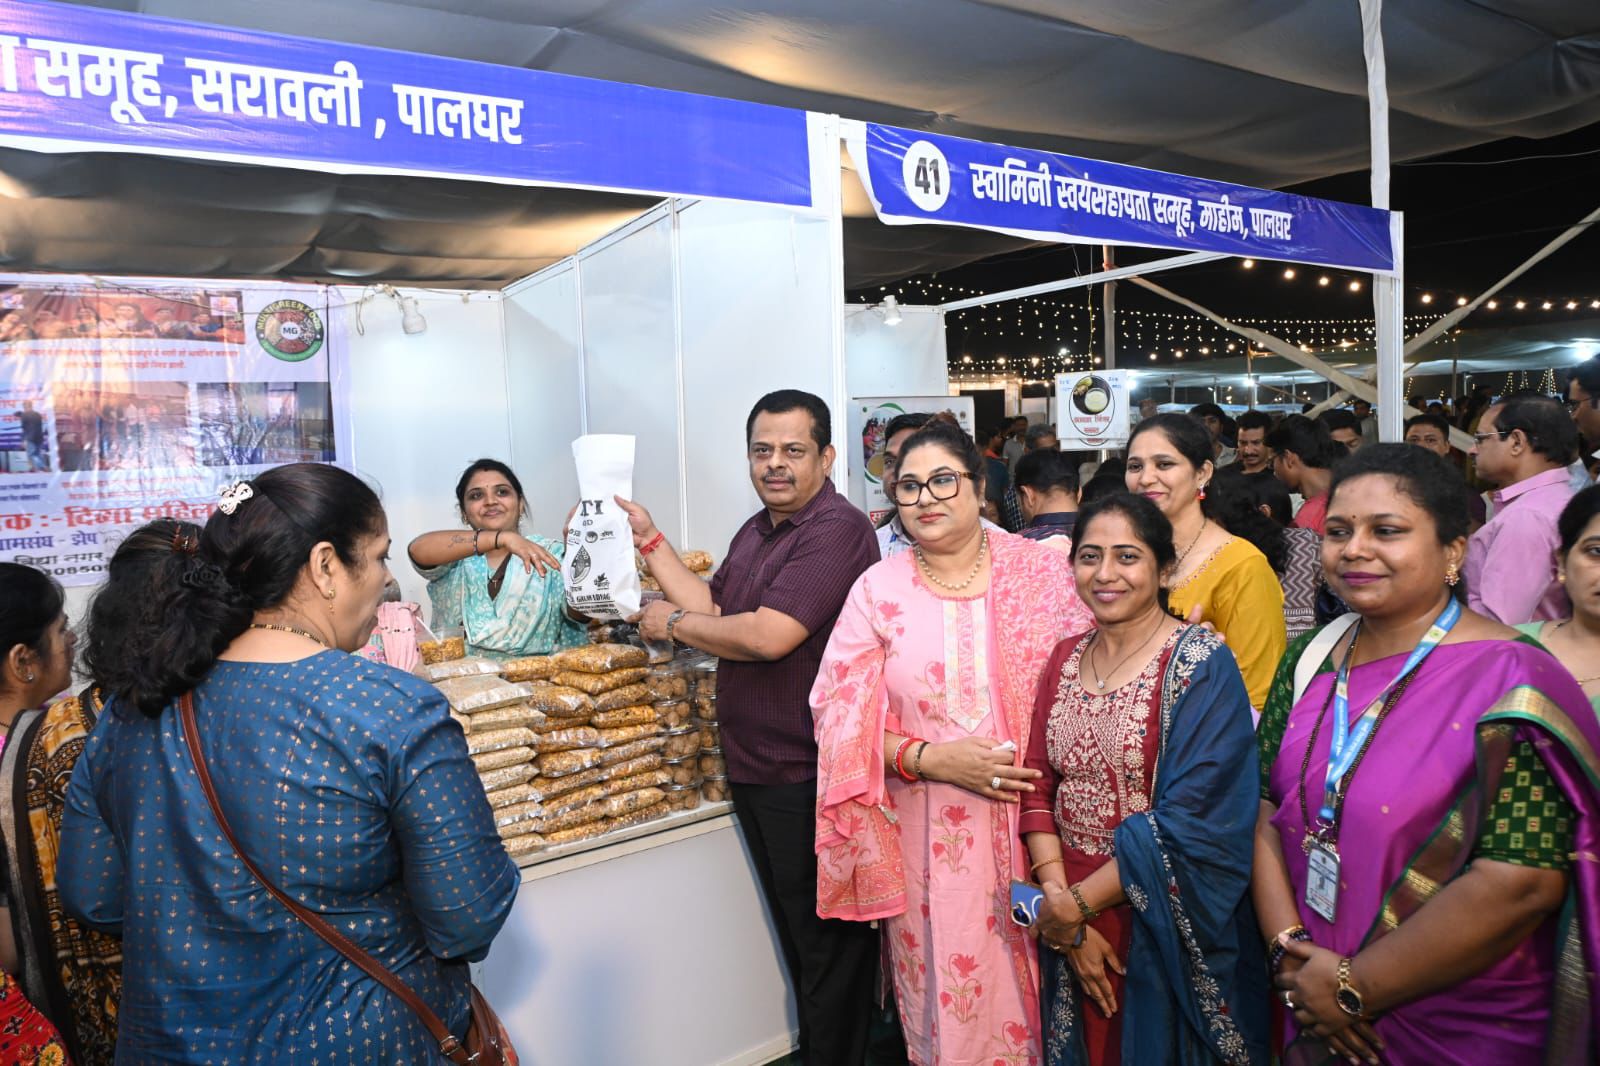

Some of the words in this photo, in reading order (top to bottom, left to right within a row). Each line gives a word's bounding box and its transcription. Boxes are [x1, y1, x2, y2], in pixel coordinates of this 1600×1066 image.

[26, 38, 178, 124] समूह,
[184, 58, 364, 127] सरावली
[392, 84, 524, 145] पालघर
[914, 157, 941, 196] 41
[968, 158, 1052, 207] स्वामिनी
[1054, 172, 1151, 222] स्वयंसहायता
[1152, 192, 1195, 237] समूह,
[1198, 194, 1249, 240] माहीम,
[1249, 207, 1293, 241] पालघर
[282, 327, 298, 335] MG
